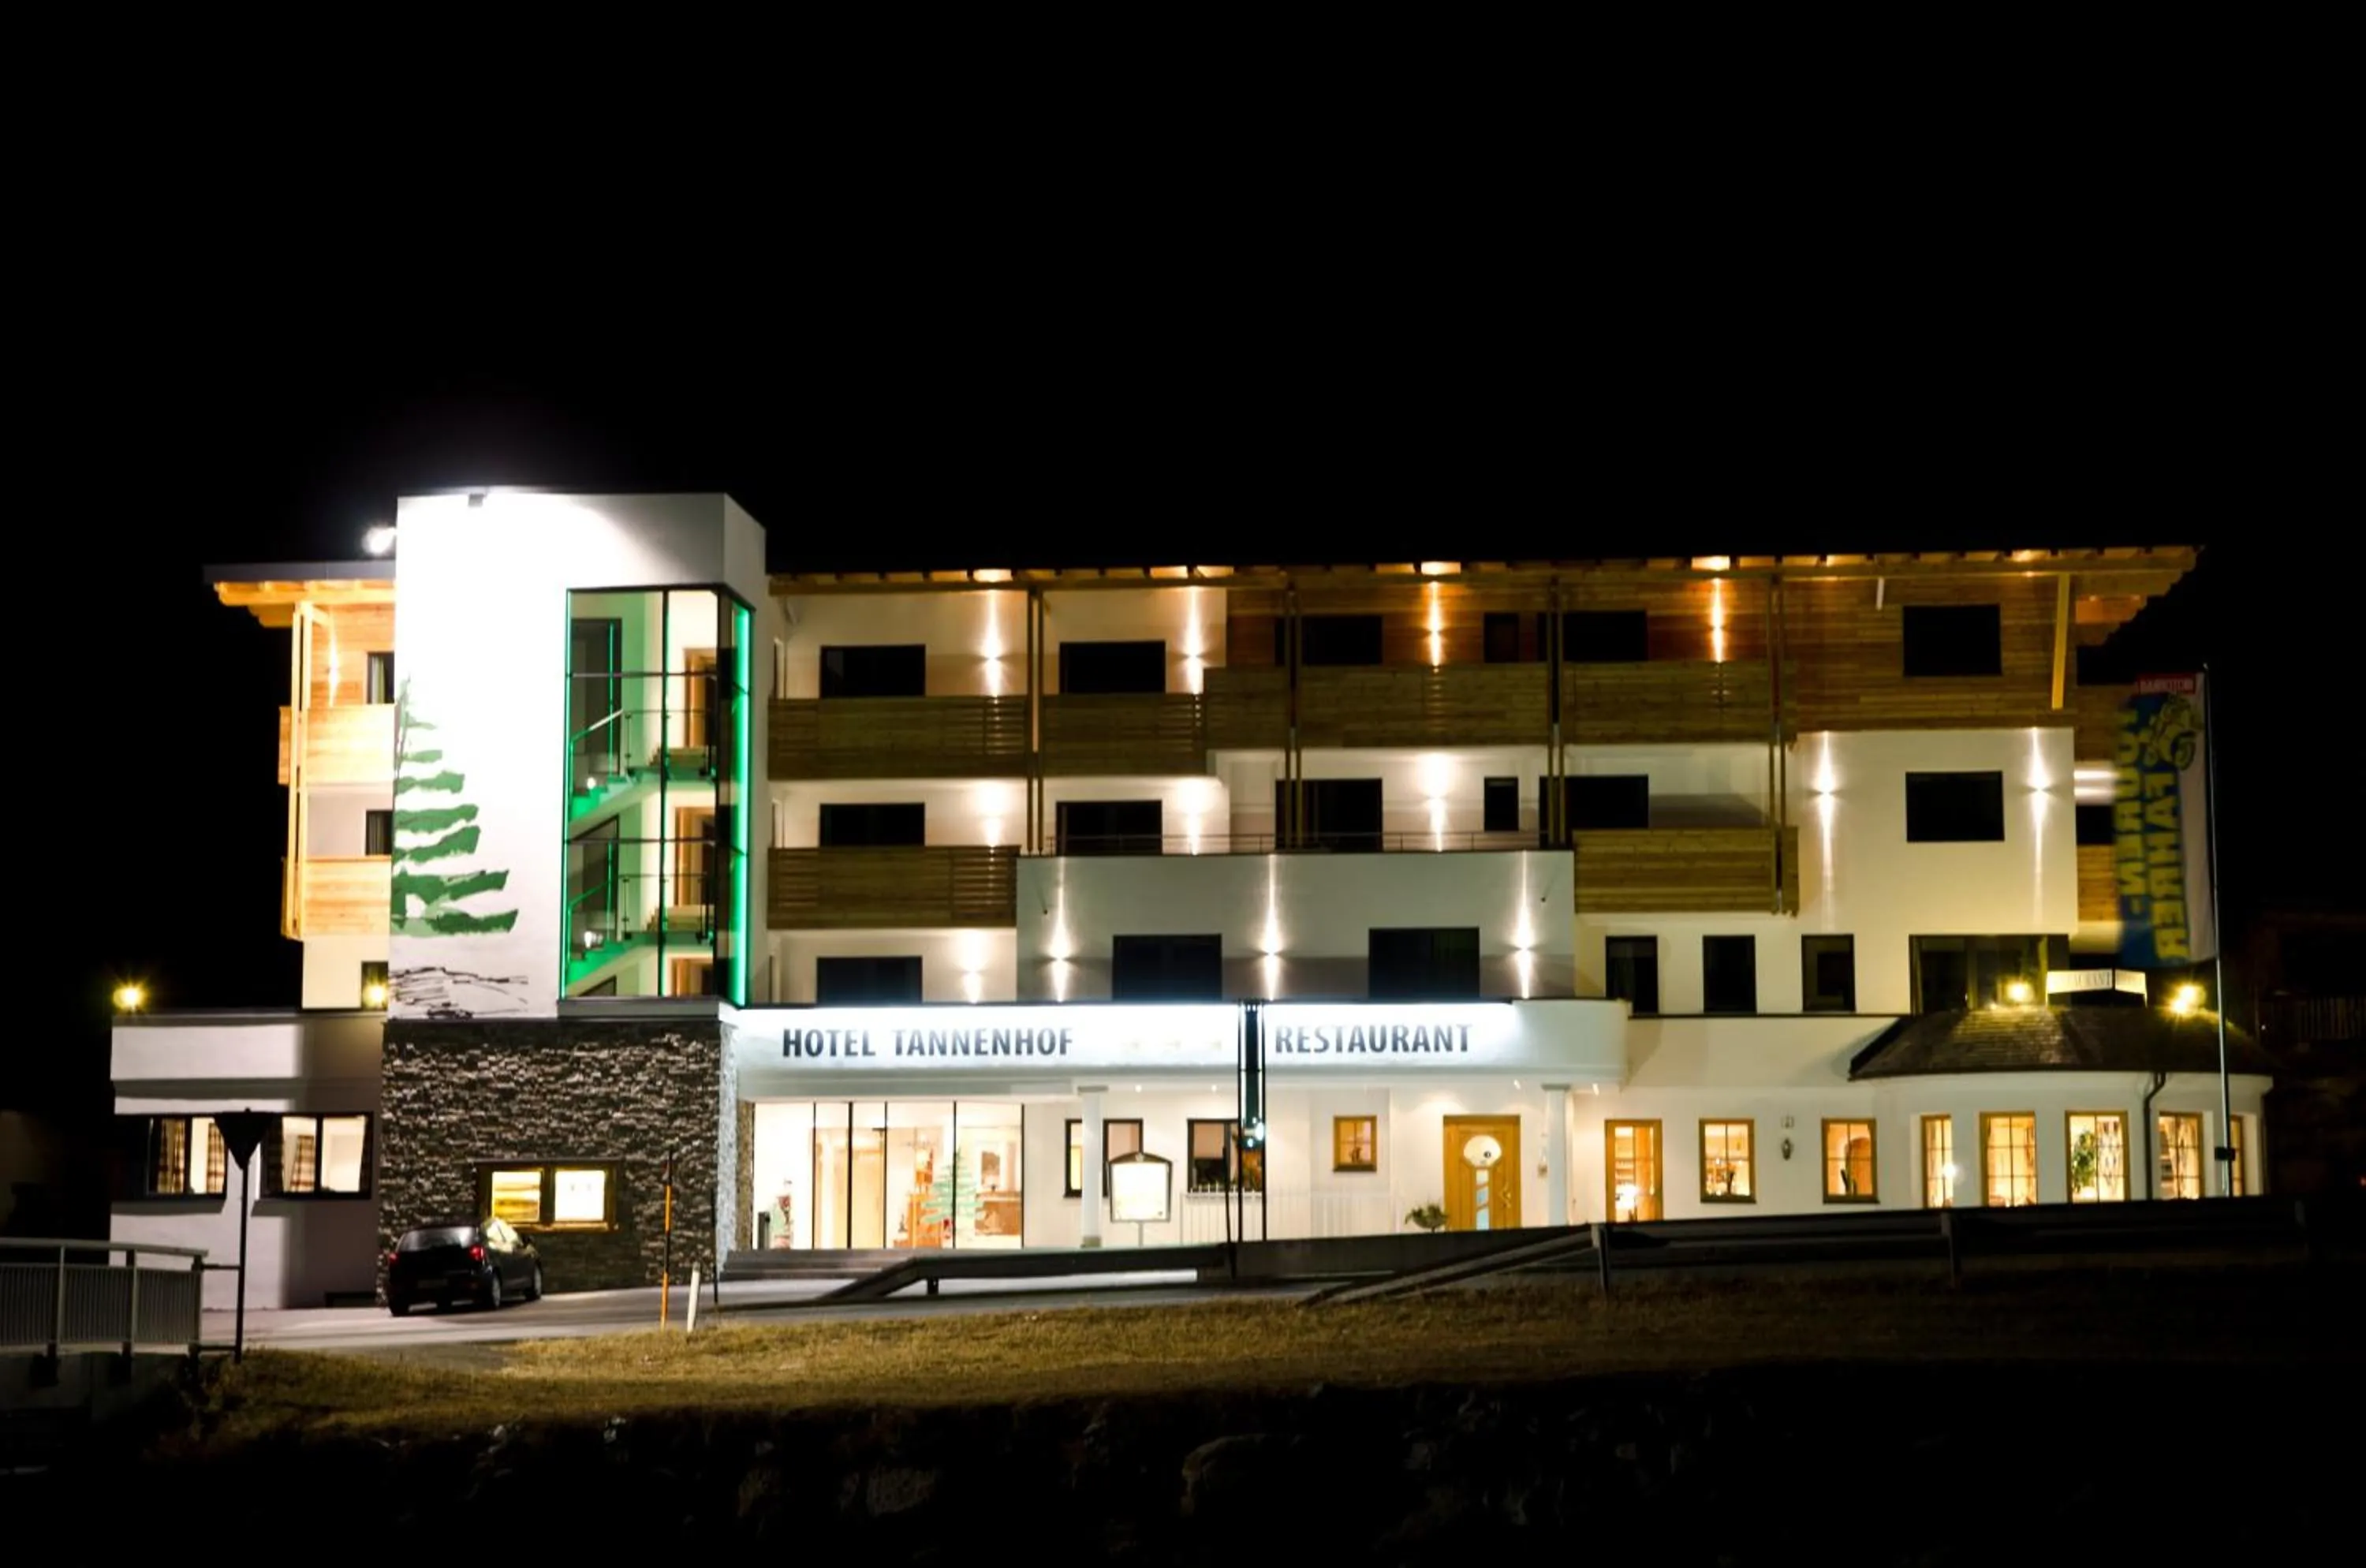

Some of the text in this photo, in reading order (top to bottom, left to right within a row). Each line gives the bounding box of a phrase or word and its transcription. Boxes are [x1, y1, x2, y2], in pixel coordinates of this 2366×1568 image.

[782, 1023, 1472, 1057] HOTEL TANNENHOF RESTAURANT
